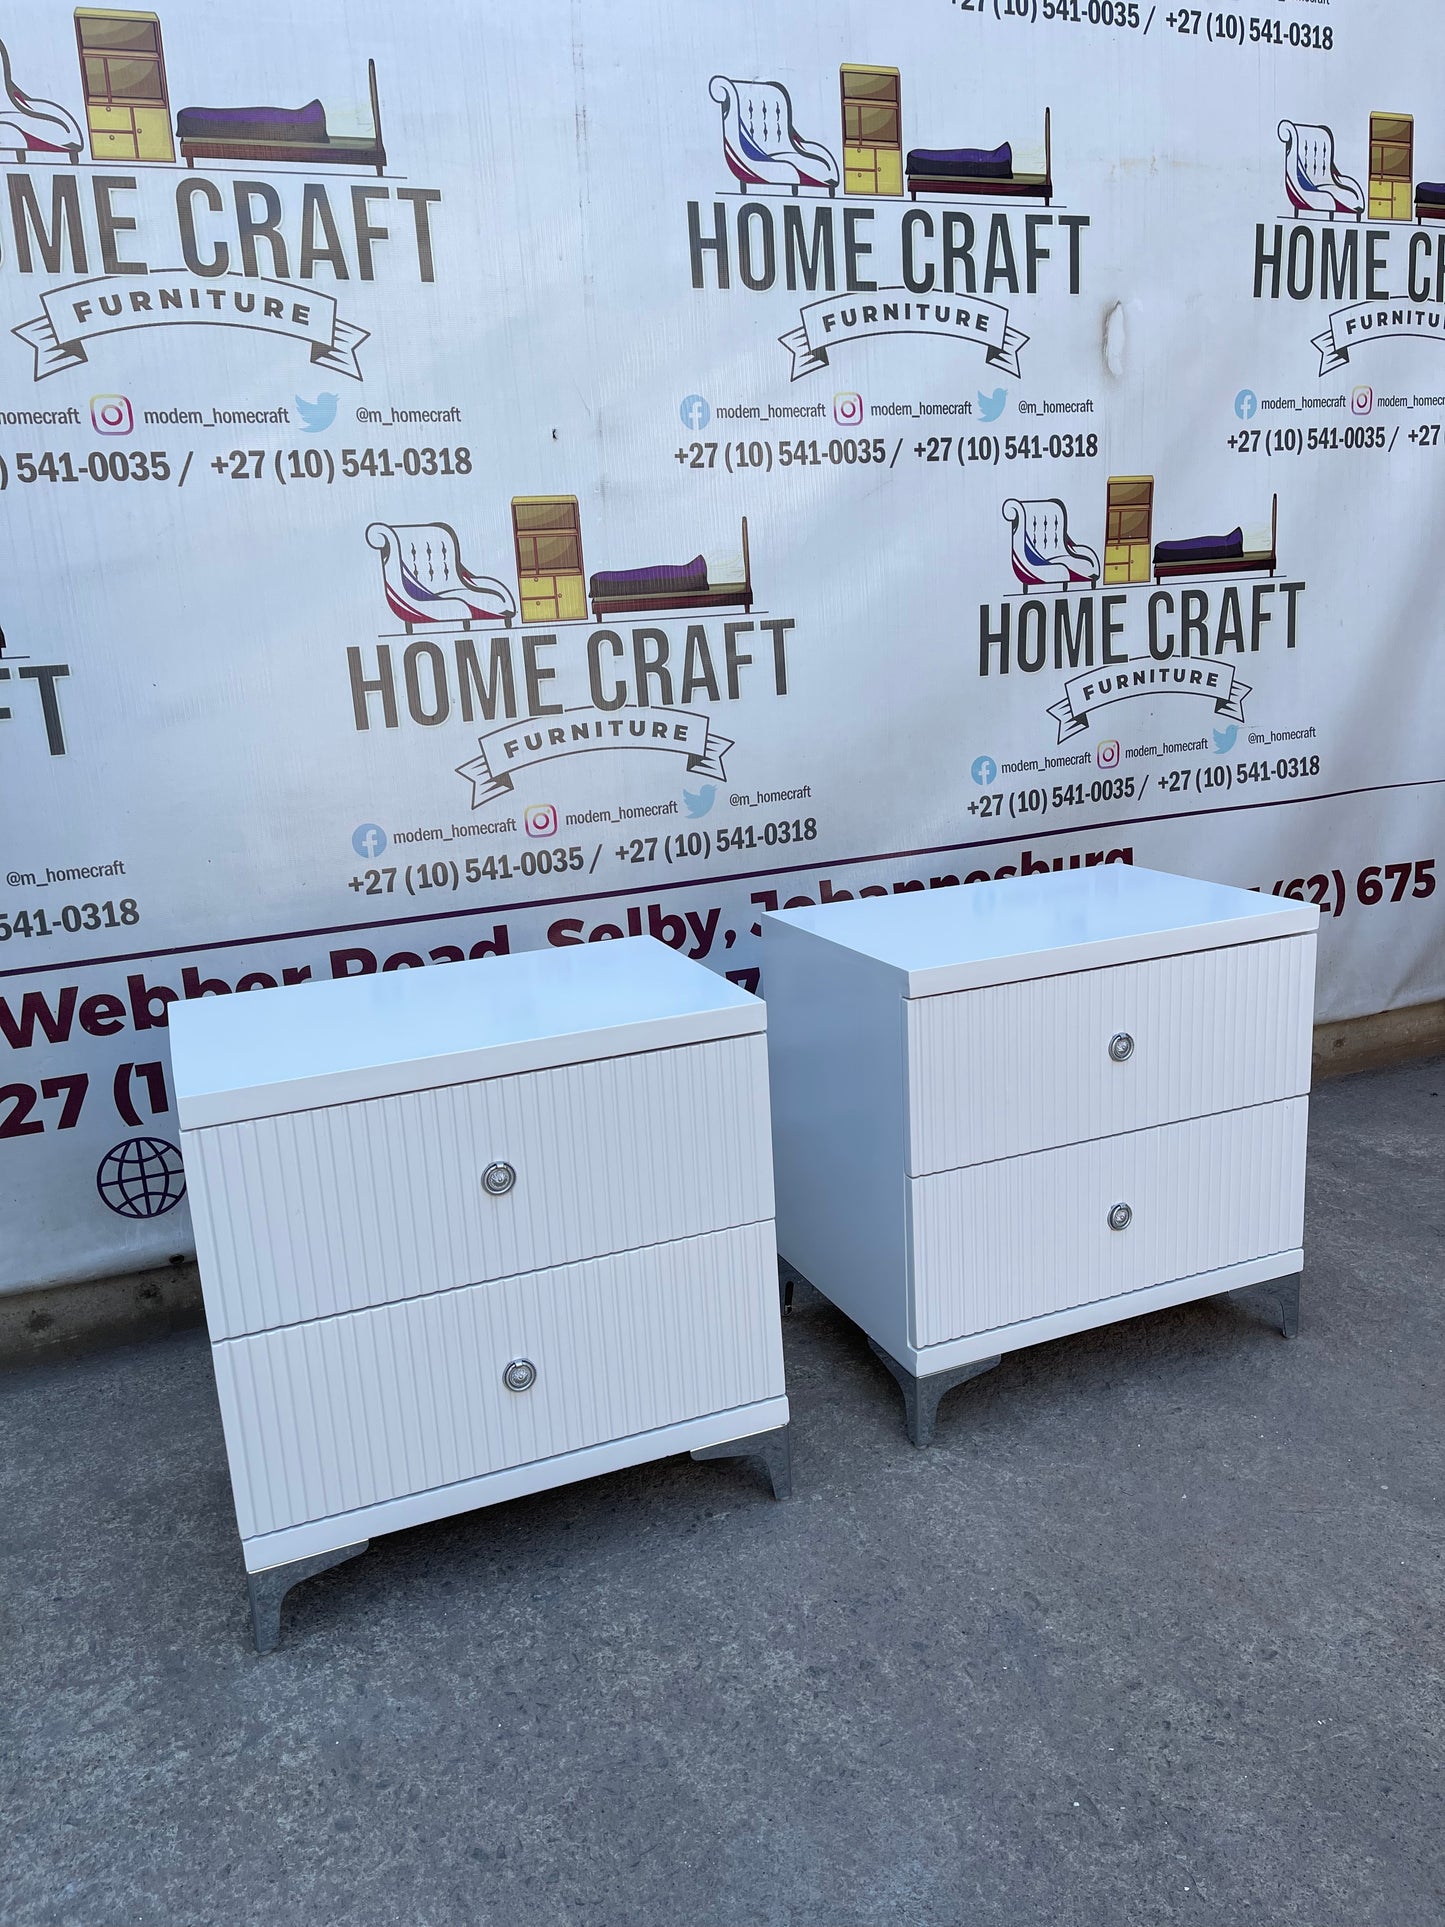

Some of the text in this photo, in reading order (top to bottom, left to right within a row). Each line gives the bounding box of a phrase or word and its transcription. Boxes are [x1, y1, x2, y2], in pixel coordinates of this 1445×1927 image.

[1042, 0, 1140, 29] 541-0035
[1143, 5, 1156, 35] /
[1165, 8, 1202, 35] +27
[1206, 12, 1245, 46] (10)
[1249, 17, 1334, 51] 541-0318
[0, 172, 442, 283] ME CRAFT
[687, 200, 1091, 295] HOME CRAFT
[1253, 223, 1391, 300] HOME
[72, 287, 312, 324] FURNITURE
[822, 302, 990, 333] FURNITURE
[1346, 309, 1445, 335] FURNITU
[356, 406, 462, 426] @m_homecraft
[1018, 399, 1094, 416] @m_homecraft
[674, 433, 1098, 474] +27 (10) 541-0035 / +27 (10) 541-0318
[1227, 424, 1441, 456] +27 (10) 541-0035 / +27
[16, 450, 171, 483] 541-0035
[178, 451, 194, 487] /
[210, 449, 266, 479] +27
[274, 449, 335, 485] (10)
[341, 446, 473, 478] 541-0318
[979, 581, 1306, 677] HOME CRAFT
[346, 618, 795, 731] HOME CRAFT
[1083, 668, 1219, 700] FURNITURE
[503, 719, 690, 760] FURNITURE
[1248, 726, 1316, 745] @m_homecraft
[729, 785, 812, 808] @m_homecraft
[967, 755, 1320, 819] +27 (10) 541-0035 / +27 (10) 541-0318
[6, 859, 126, 887] @m_homecraft
[348, 817, 818, 896] +27 (10) 541-0035 / +27 (10) 541-0318
[1356, 859, 1436, 906] 675
